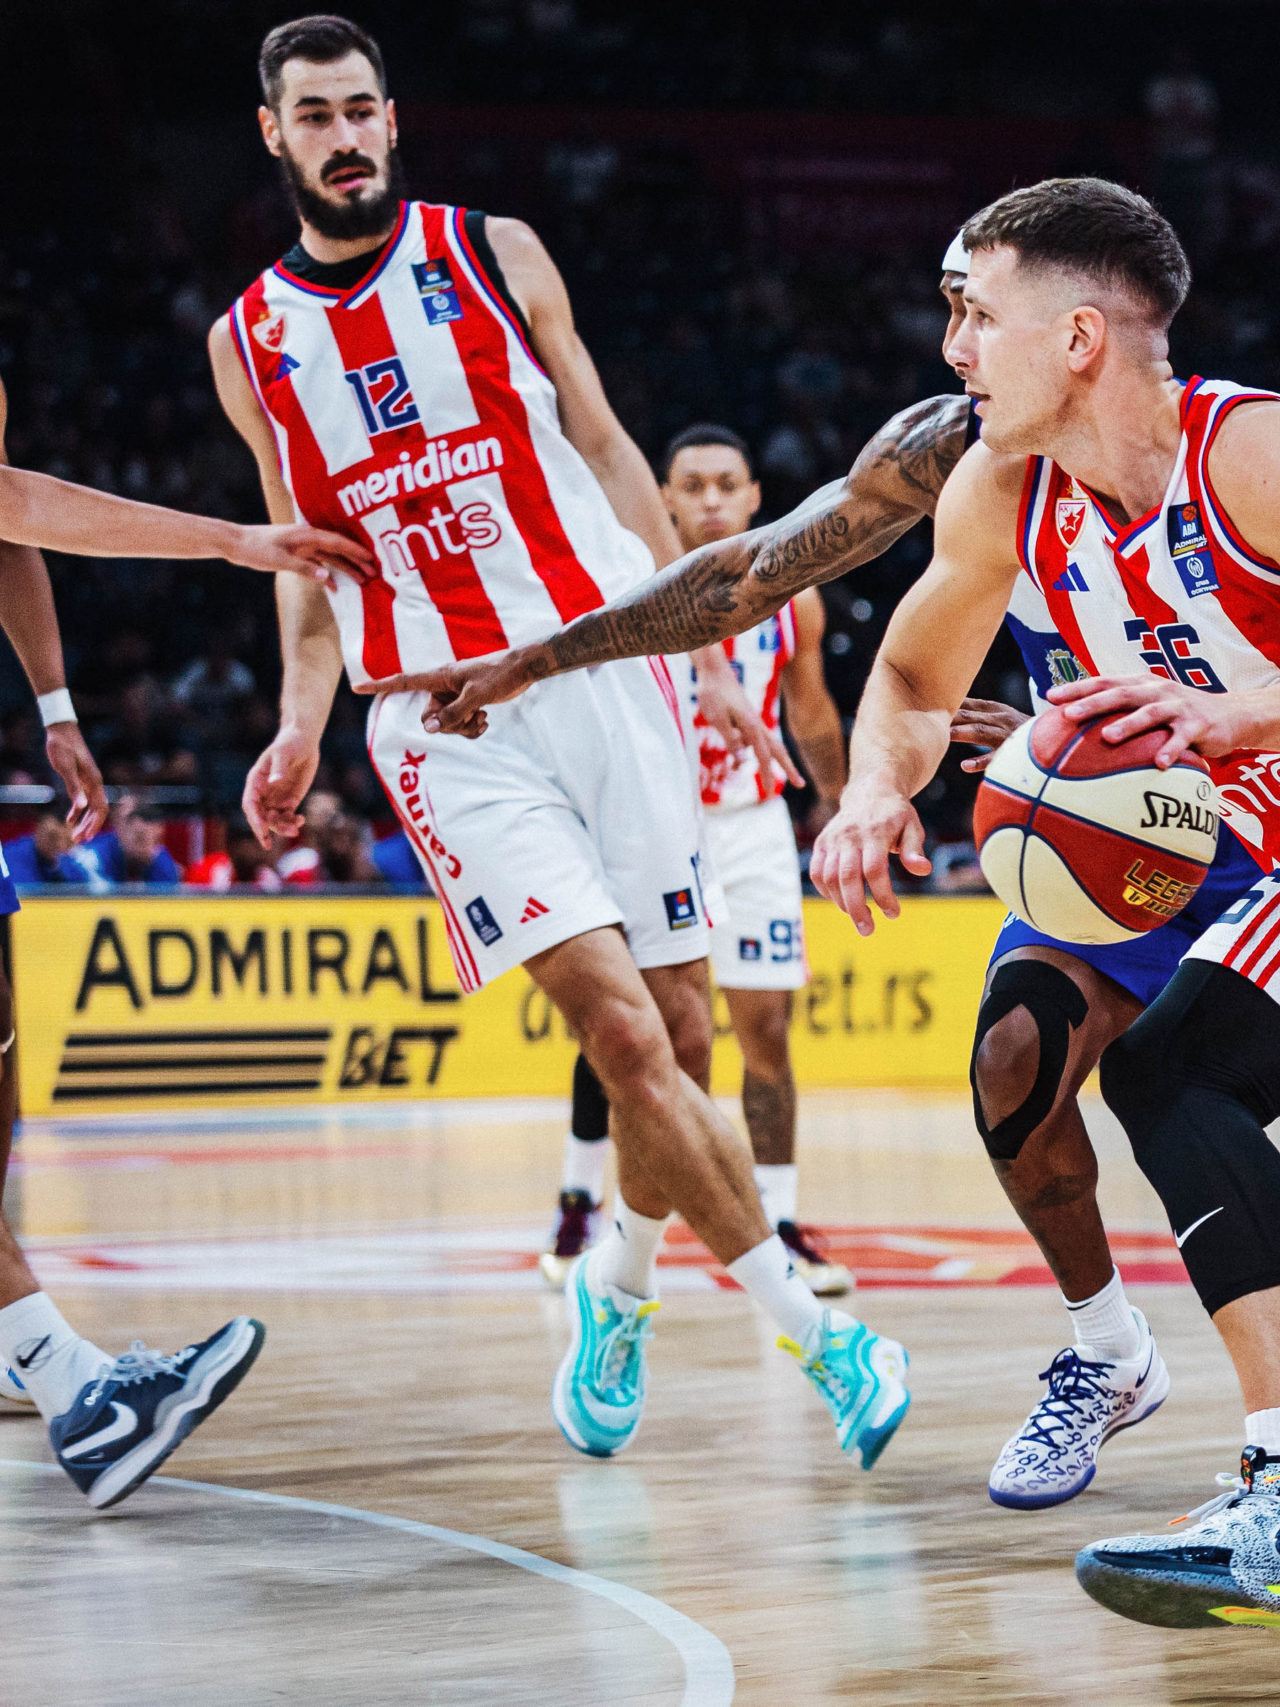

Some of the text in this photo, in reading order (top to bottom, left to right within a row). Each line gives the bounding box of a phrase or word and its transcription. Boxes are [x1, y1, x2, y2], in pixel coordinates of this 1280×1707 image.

[344, 356, 422, 437] 12
[337, 437, 504, 517] meridian
[379, 502, 501, 577] mts
[1174, 534, 1208, 550] ADMIRAL
[74, 914, 462, 1013] ADMIRAL
[337, 1026, 461, 1088] BET
